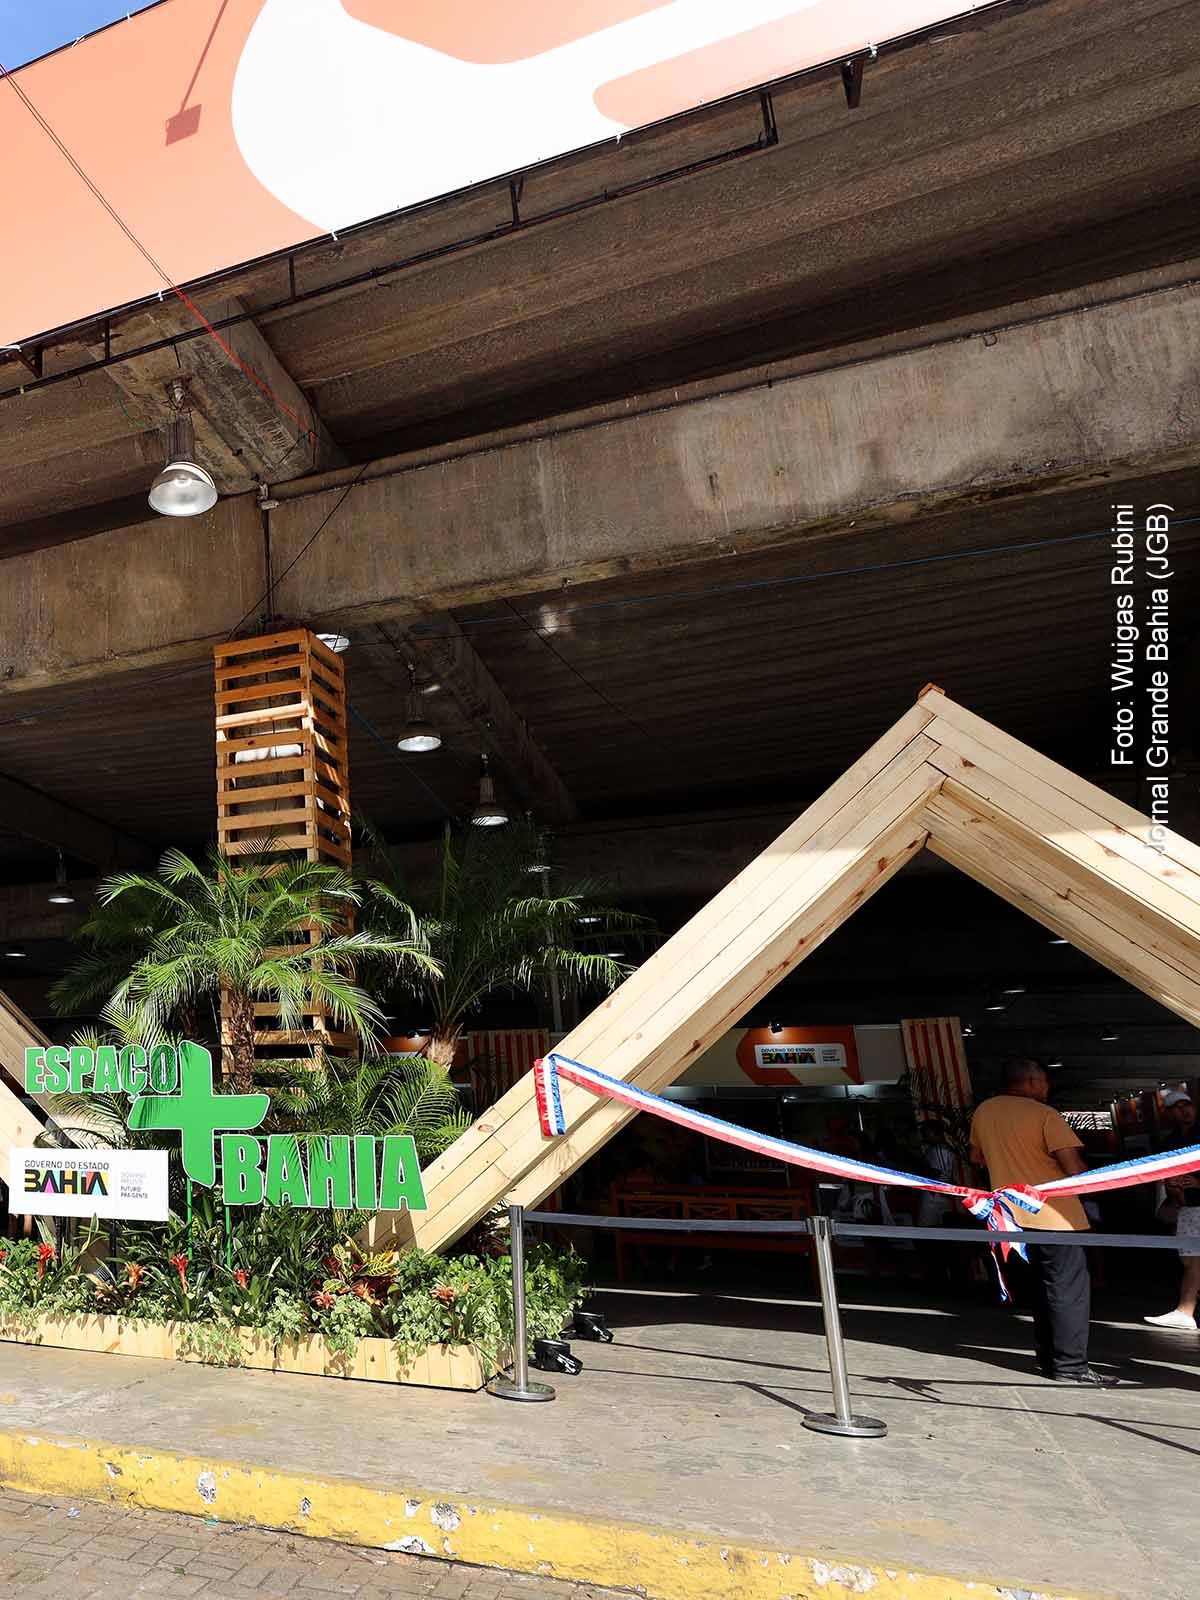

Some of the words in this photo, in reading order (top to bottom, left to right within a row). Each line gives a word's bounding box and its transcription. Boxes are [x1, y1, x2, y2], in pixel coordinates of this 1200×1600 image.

[762, 1052, 817, 1064] BAHIA
[23, 1044, 179, 1102] ESPAÇO
[24, 1159, 63, 1169] GOVERNO
[64, 1160, 76, 1169] DO
[78, 1161, 110, 1171] ESTADO
[221, 1133, 428, 1212] BAHIA
[24, 1168, 109, 1196] BAHIA
[120, 1185, 142, 1193] FUTURO
